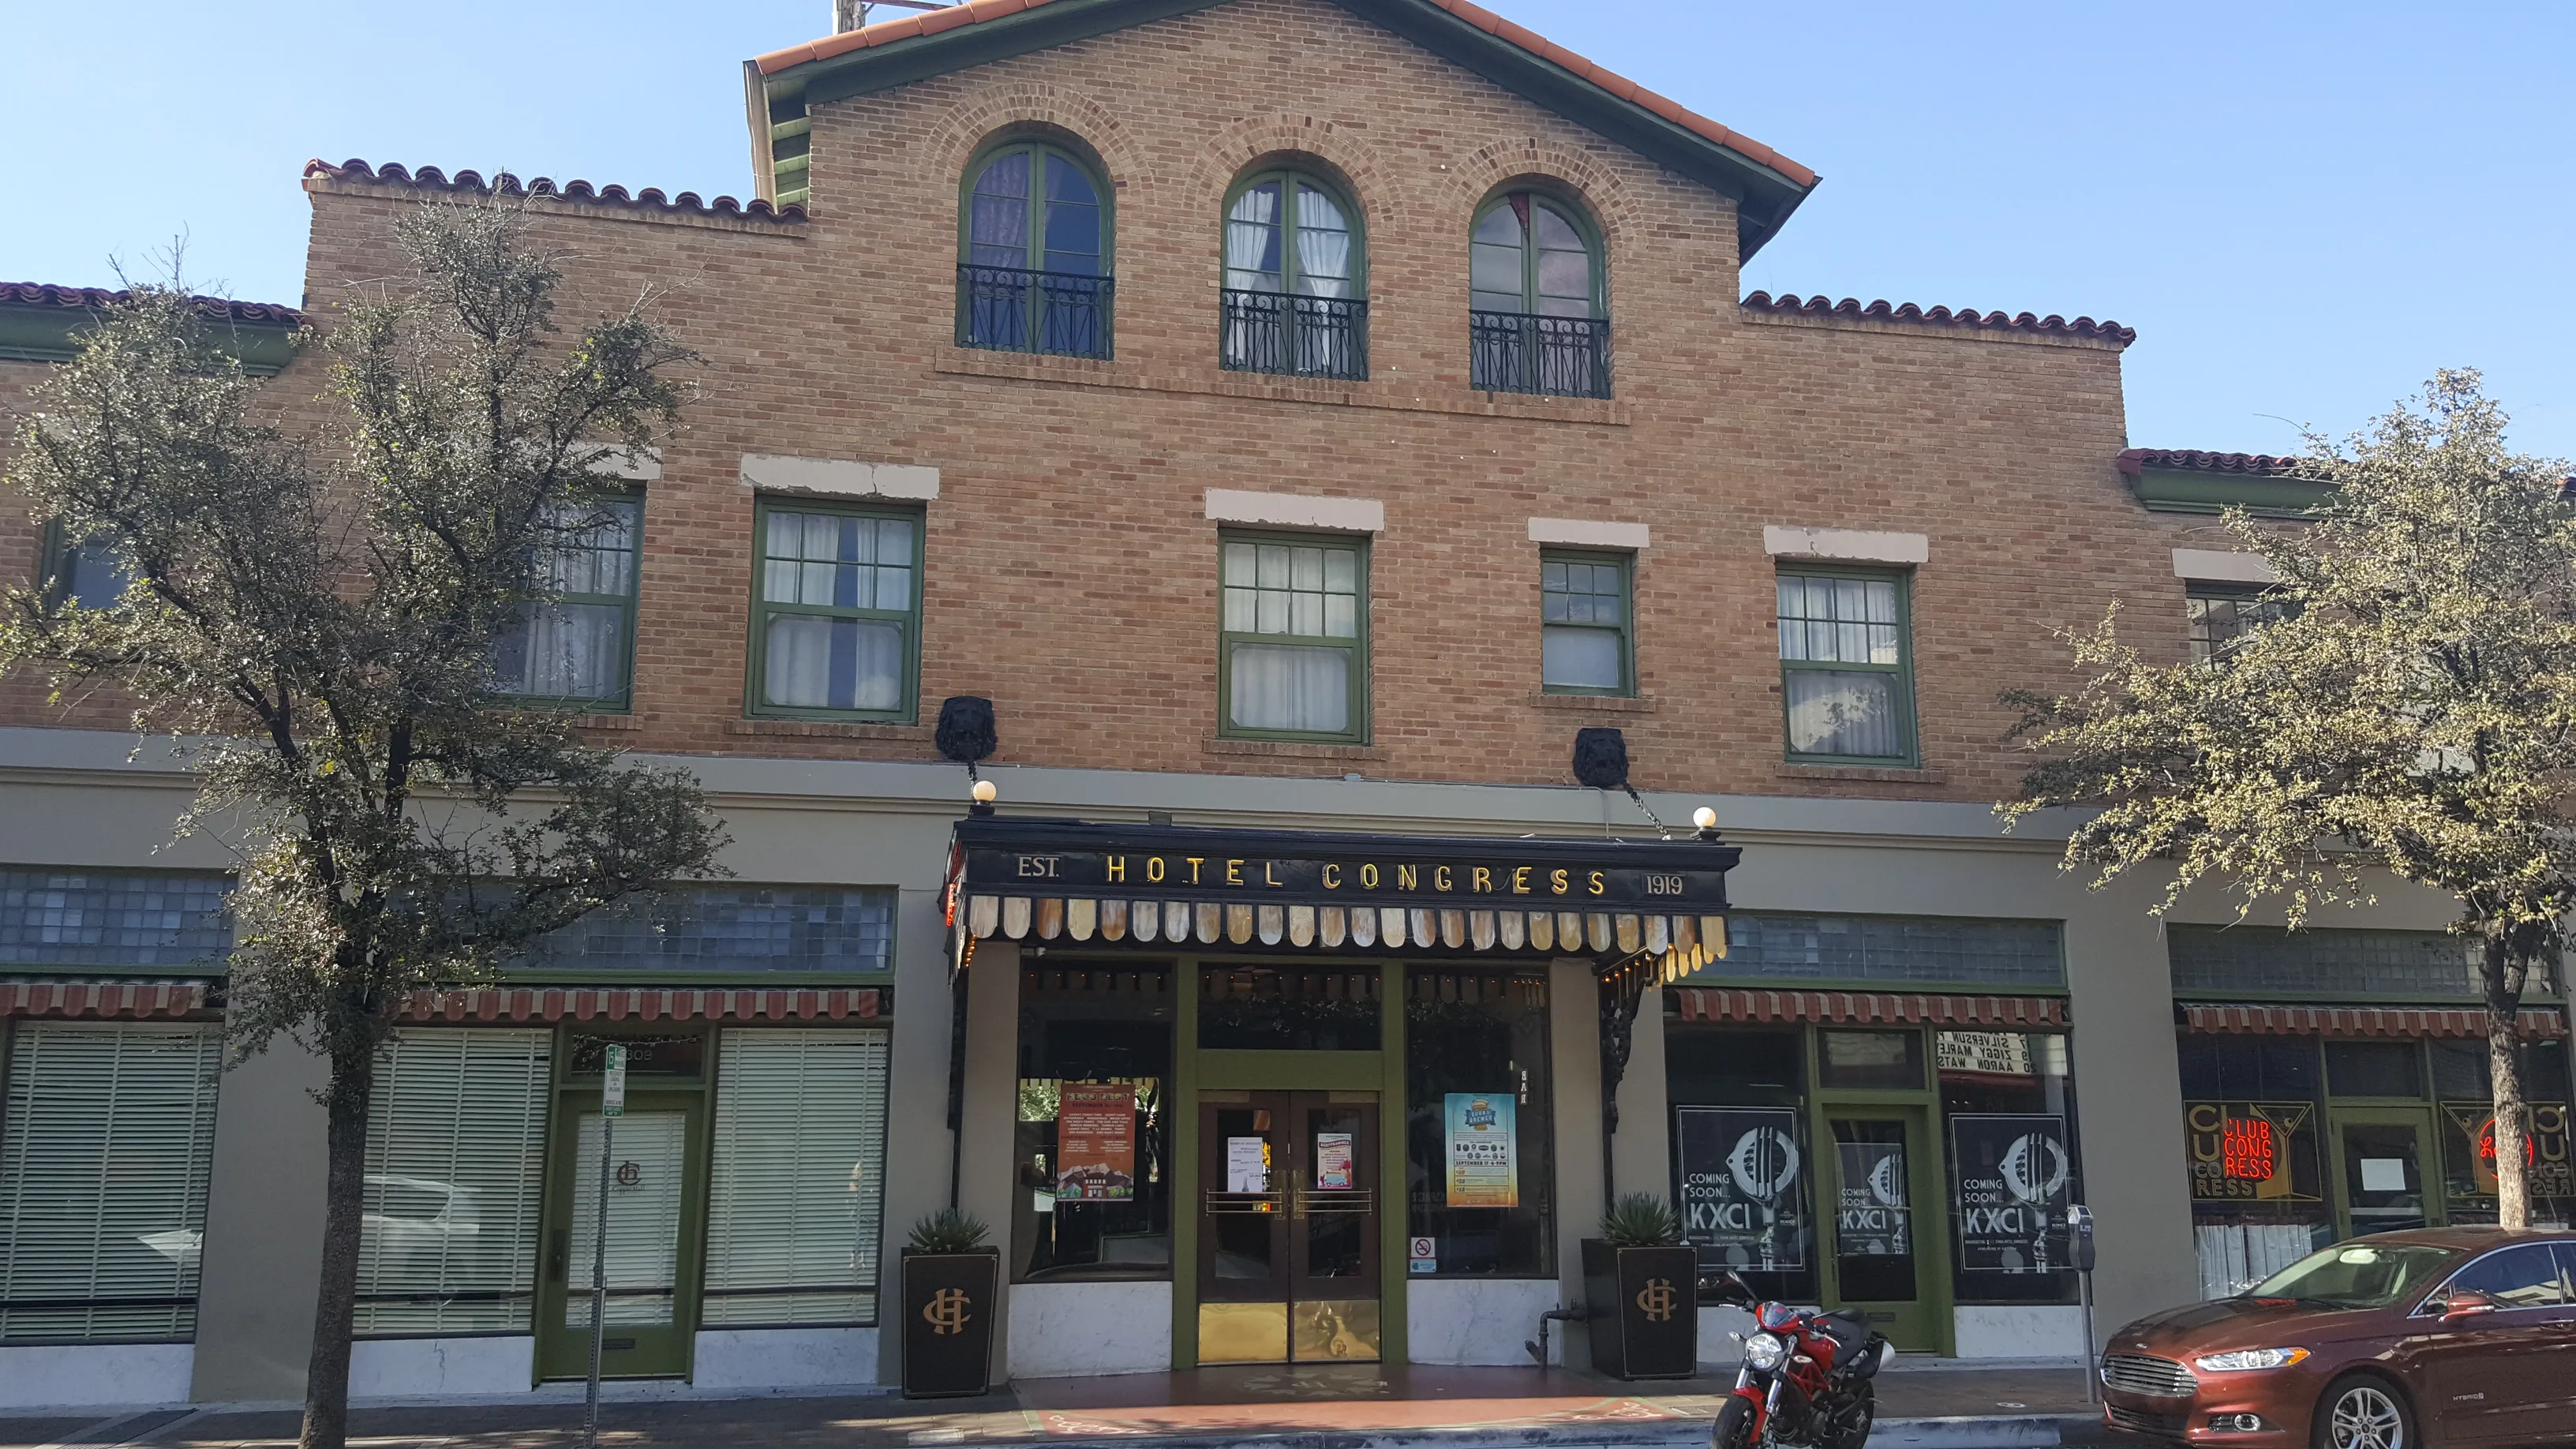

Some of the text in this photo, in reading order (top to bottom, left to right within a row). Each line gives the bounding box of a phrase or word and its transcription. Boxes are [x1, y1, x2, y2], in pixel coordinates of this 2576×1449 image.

[1018, 856, 1060, 878] EST.
[1106, 855, 1604, 896] HOTEL CONGRESS
[1646, 874, 1683, 896] 1919
[2224, 1137, 2272, 1158] CONG
[1689, 1173, 1730, 1184] COMING
[2226, 1156, 2272, 1180] RESS
[1841, 1188, 1871, 1196] COMING
[1964, 1179, 2003, 1189] COMING
[2196, 1178, 2252, 1196] RESS
[1690, 1202, 1750, 1230] KXCI
[1842, 1210, 1886, 1230] KXCI
[1965, 1208, 2024, 1234] KXCI
